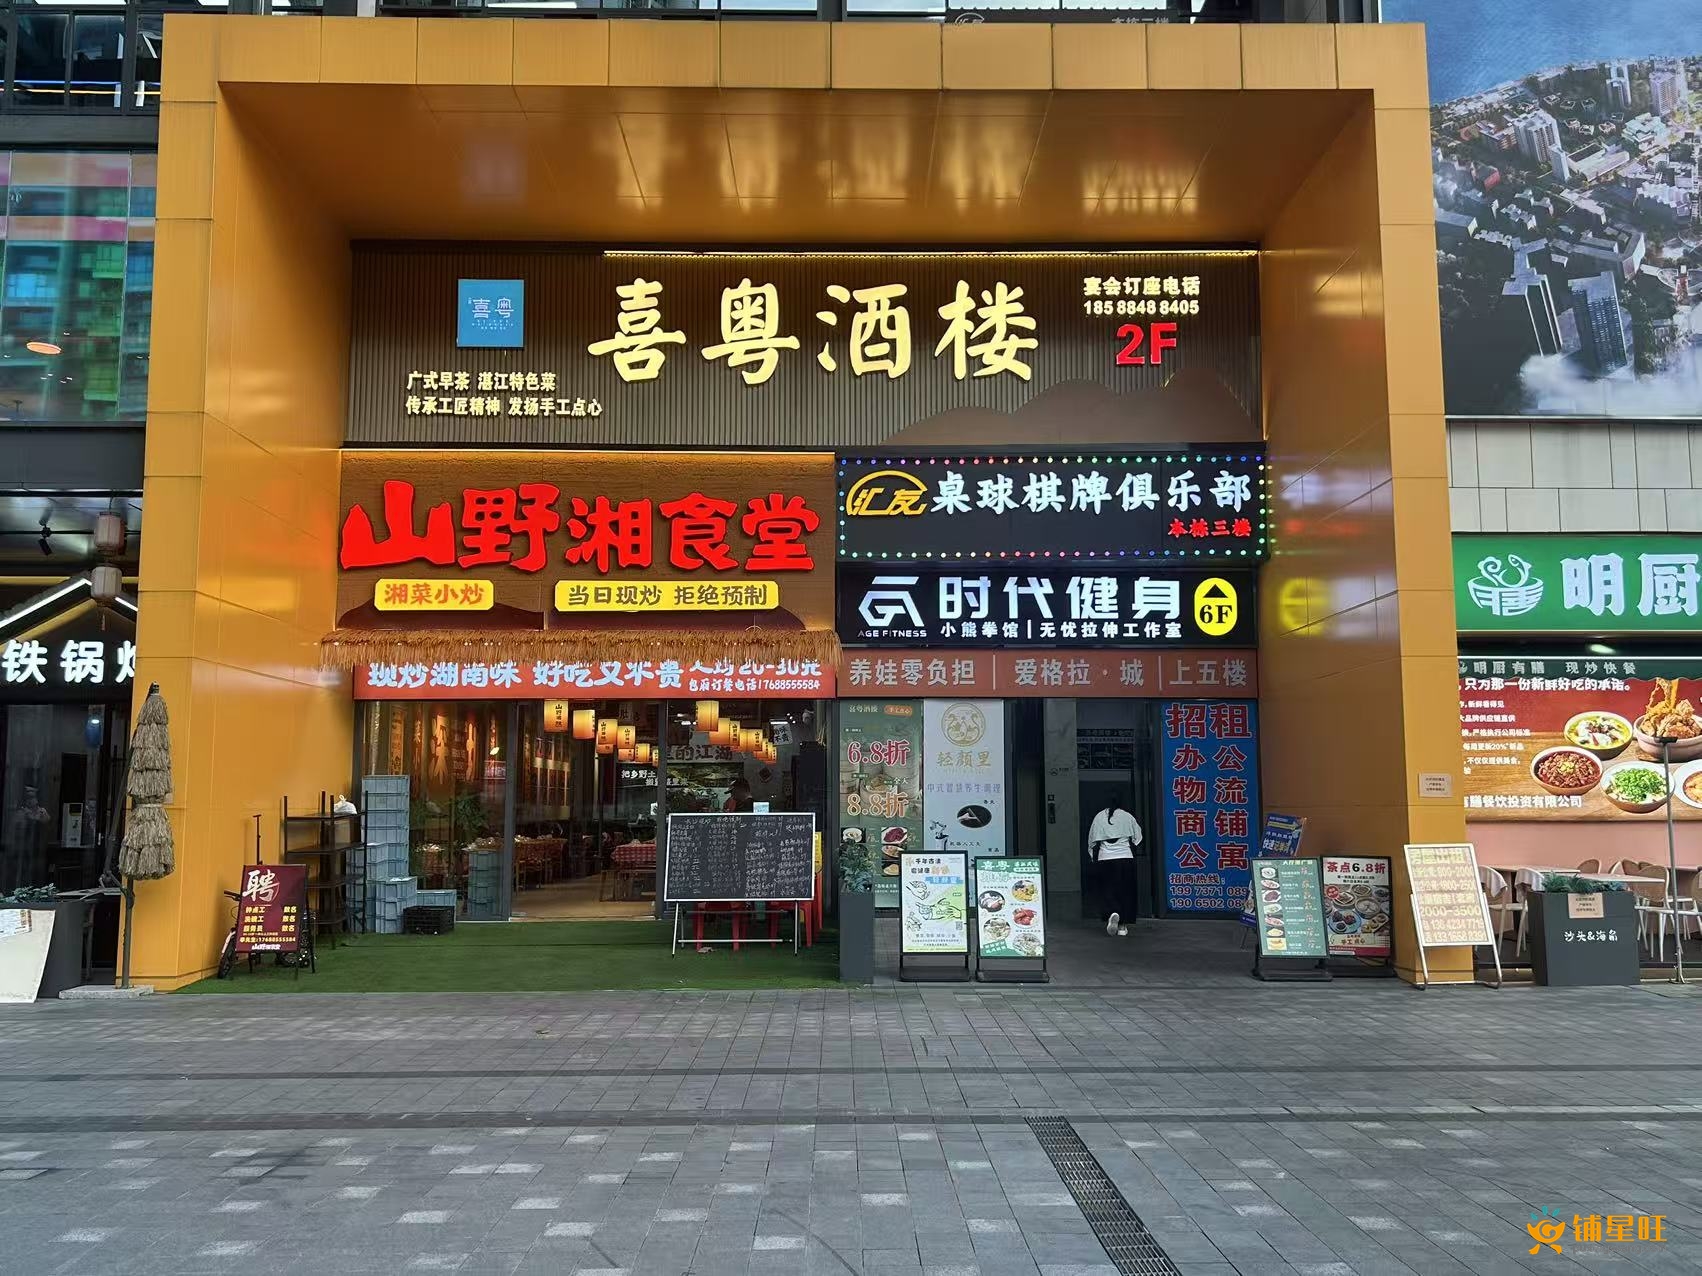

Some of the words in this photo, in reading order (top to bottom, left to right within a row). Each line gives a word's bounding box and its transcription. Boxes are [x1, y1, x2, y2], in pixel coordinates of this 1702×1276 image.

[1083, 276, 1201, 295] 宴会订座电话
[472, 297, 514, 319] 喜粤
[1083, 300, 1114, 315] 185
[1116, 300, 1157, 316] 8848
[1159, 300, 1200, 316] 8405
[588, 277, 1039, 386] 喜粤酒楼
[1115, 322, 1177, 366] 2F
[406, 371, 470, 391] 广式早茶
[477, 371, 556, 391] 湛江特色菜
[405, 396, 501, 417] 传承工匠精神
[508, 397, 603, 418] 发扬手工点心
[931, 470, 1252, 515] 桌球棋牌俱乐部
[339, 479, 820, 574] 山野湘食堂
[384, 583, 485, 606] 湘菜小炒
[567, 585, 664, 606] 当日现炒
[674, 584, 768, 606] 拒绝预制
[938, 576, 1181, 619] 时代健身
[1561, 553, 1701, 616] 明厨
[1200, 603, 1233, 625] 6F
[858, 629, 880, 638] AGE
[882, 629, 928, 638] FITNESS
[367, 659, 522, 689] 现炒湖南味
[532, 659, 684, 689] 好吃又不贵
[849, 658, 976, 687] 养娃零负担
[1169, 658, 1248, 687] 上五楼
[1473, 661, 1545, 675] 明厨有膳
[1565, 661, 1637, 675] 现炒快餐
[1166, 703, 1251, 739] 招租
[847, 739, 911, 767] 6.8折
[1173, 744, 1246, 771] 办公
[1173, 777, 1249, 804] 物流
[847, 792, 911, 818] 8.8折
[1174, 809, 1249, 837] 商铺
[1175, 843, 1250, 871] 公寓
[1327, 861, 1386, 875] 茶点6.8折
[242, 869, 281, 904] 聘
[1170, 886, 1192, 896] 199
[1195, 886, 1223, 896] 7371
[1170, 898, 1192, 908] 190
[1195, 898, 1225, 908] 6502
